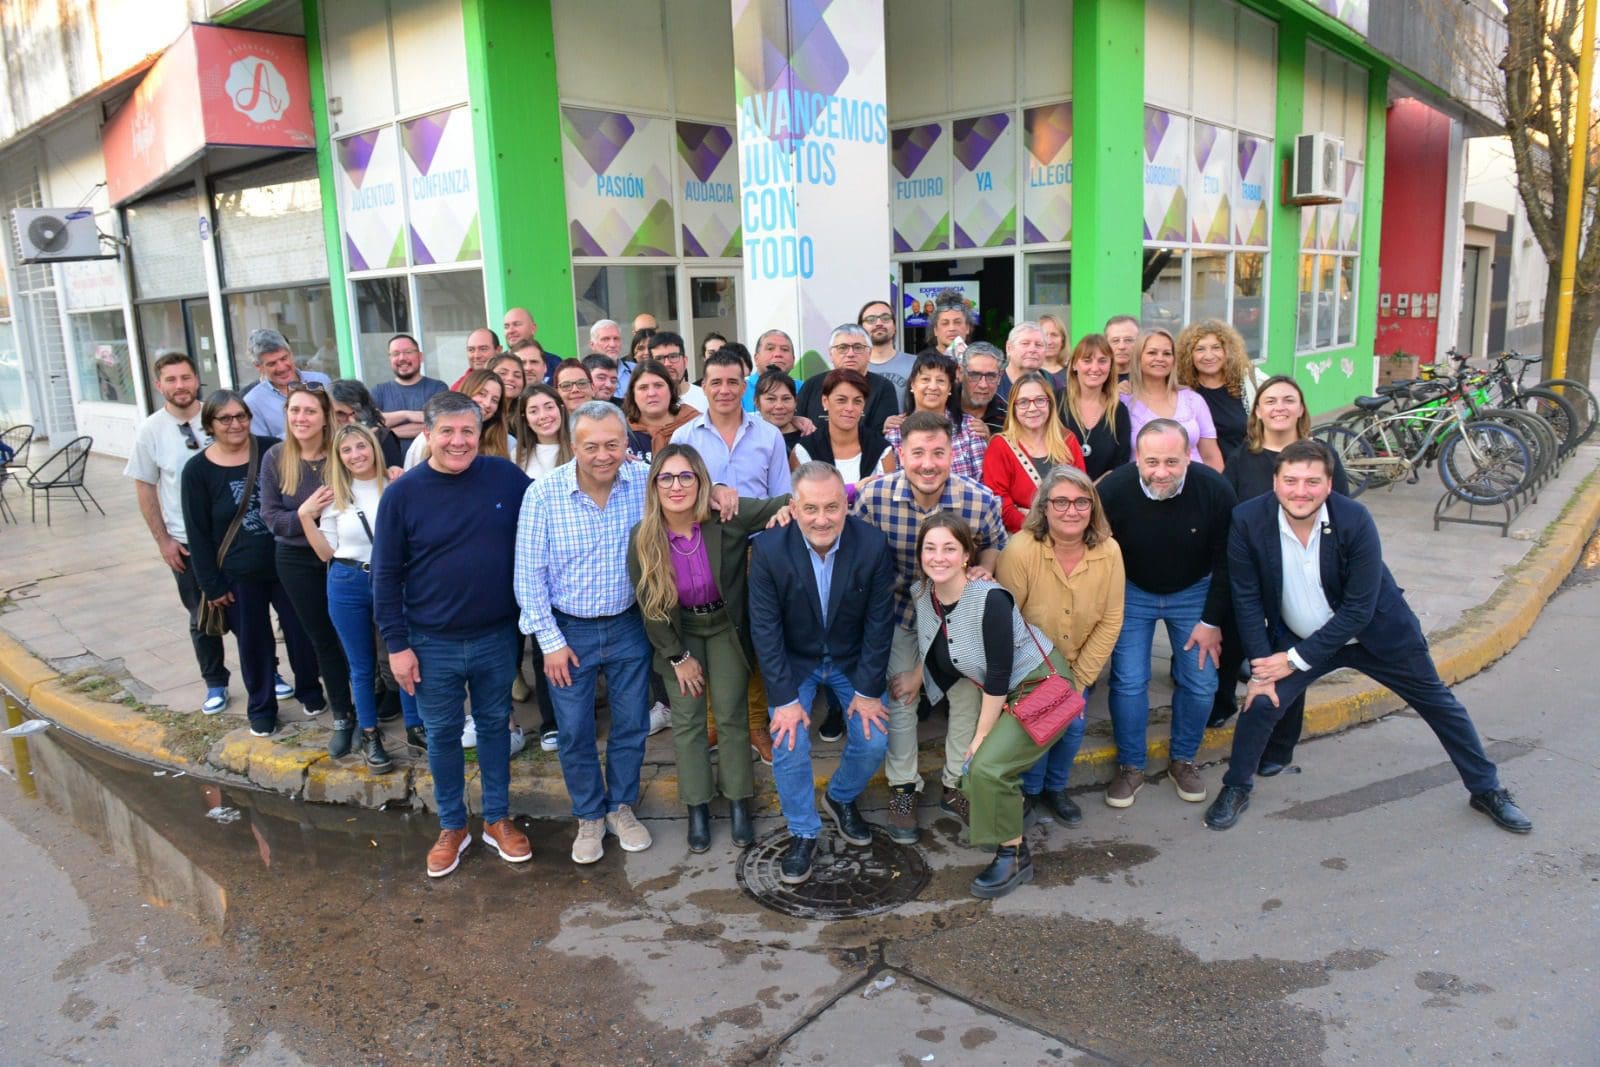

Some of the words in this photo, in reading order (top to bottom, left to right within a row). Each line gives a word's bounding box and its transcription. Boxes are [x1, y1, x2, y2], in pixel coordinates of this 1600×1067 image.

[741, 89, 887, 144] AVANCEMOS
[742, 138, 836, 188] JUNTOS
[352, 182, 396, 212] JUVENTUD
[413, 168, 471, 200] CONFIANZA
[597, 173, 645, 198] PASIÓN
[685, 180, 734, 202] AUDACIA
[896, 177, 944, 200] FUTURO
[976, 171, 993, 192] YA
[743, 188, 796, 232] CON
[745, 235, 814, 280] TODO
